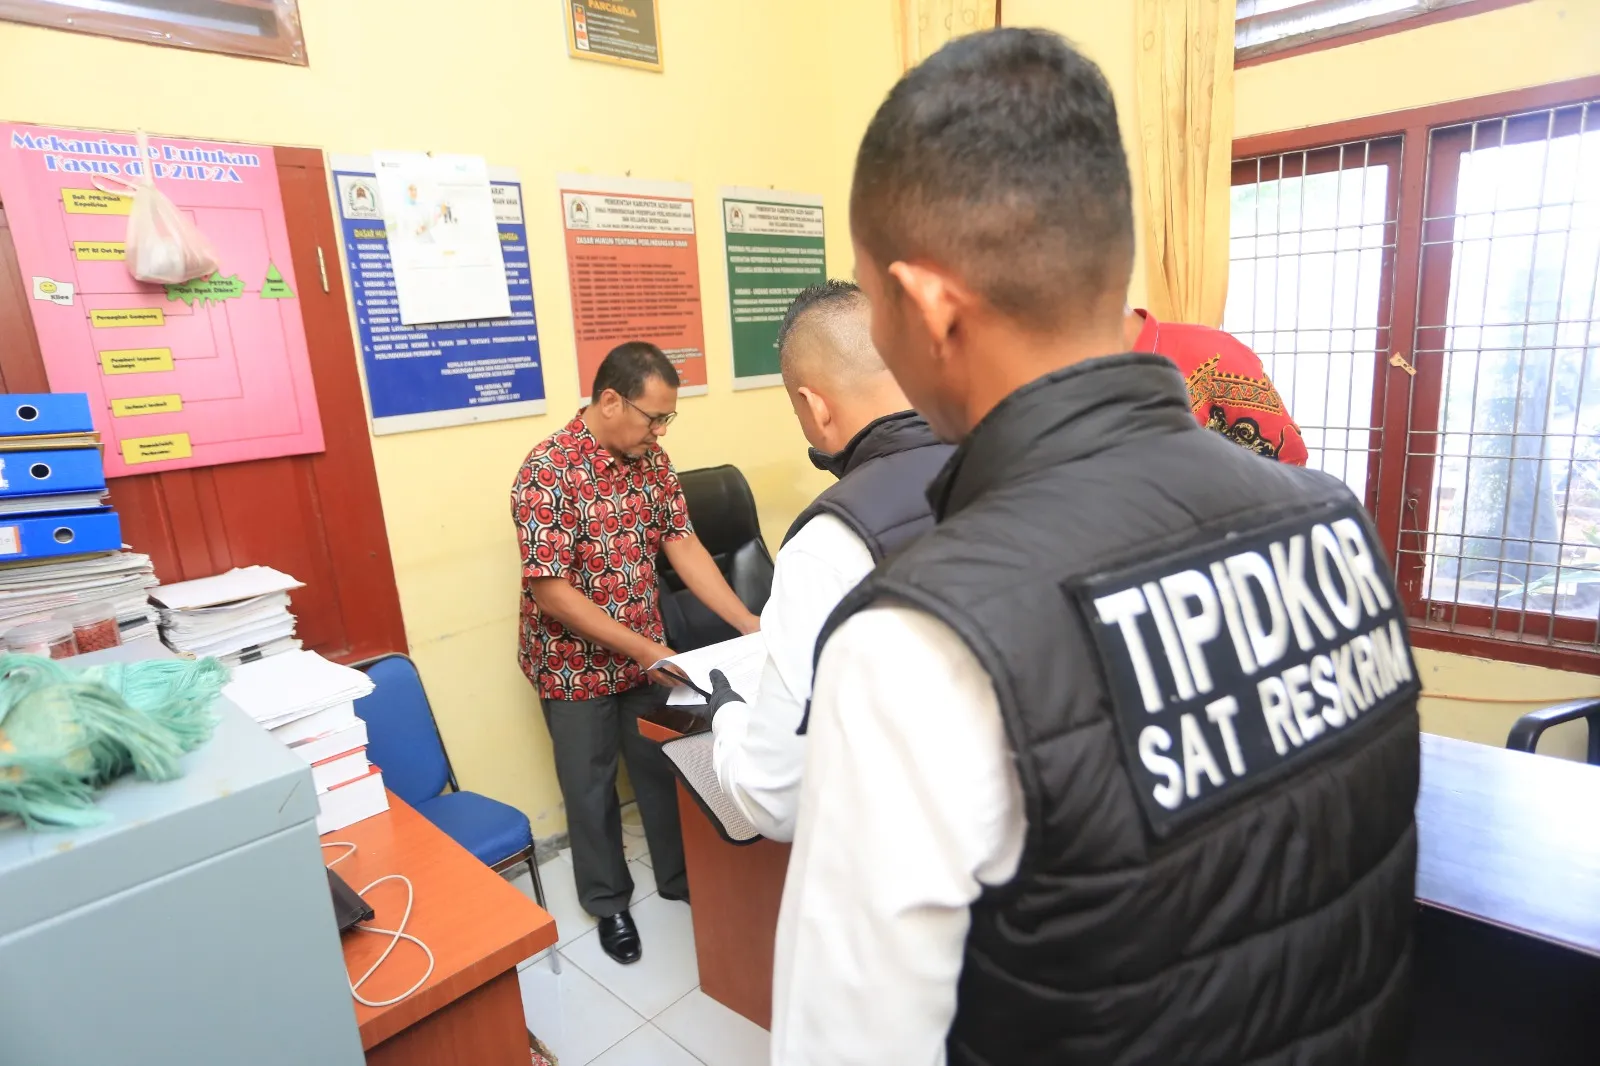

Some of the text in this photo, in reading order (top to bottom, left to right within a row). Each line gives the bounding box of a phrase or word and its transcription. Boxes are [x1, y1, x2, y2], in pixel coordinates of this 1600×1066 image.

[45, 154, 121, 176] Kasus
[153, 162, 243, 184] P2TP2A
[162, 144, 260, 168] Rujukan
[576, 236, 594, 245] DASAR
[594, 237, 614, 245] HUKUM
[614, 238, 637, 246] TENTANG
[637, 239, 675, 247] PERLINDUNGAN
[1093, 517, 1392, 714] TIPIDKOR
[1138, 619, 1413, 810] SAT RESKRIM
